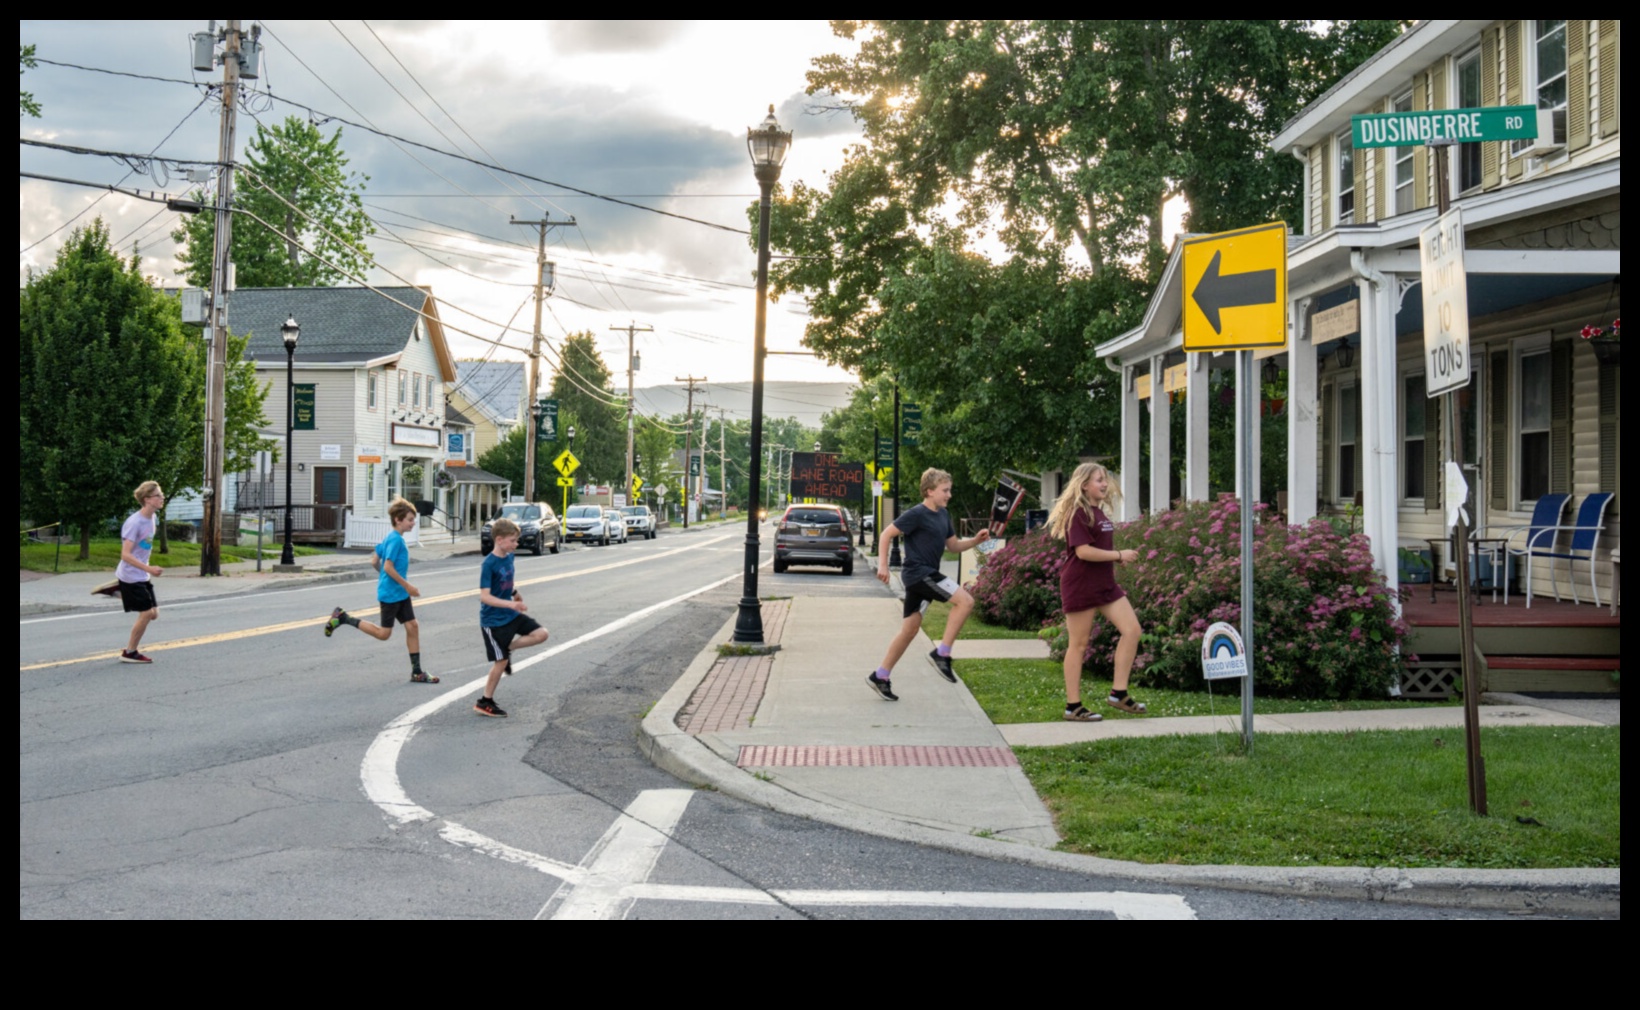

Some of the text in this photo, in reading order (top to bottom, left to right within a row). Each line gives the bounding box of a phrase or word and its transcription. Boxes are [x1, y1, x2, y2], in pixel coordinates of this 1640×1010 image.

[1361, 113, 1523, 144] DUSINBERRE RD
[1425, 223, 1459, 265] WEIGHT
[1430, 261, 1455, 296] LIMIT
[1438, 301, 1452, 334] 10
[1431, 338, 1463, 379] TONS
[792, 468, 862, 482] LANE ROAD
[815, 454, 840, 466] ONE
[806, 484, 846, 496] AHEAD
[1206, 660, 1244, 671] GOOD VIBES
